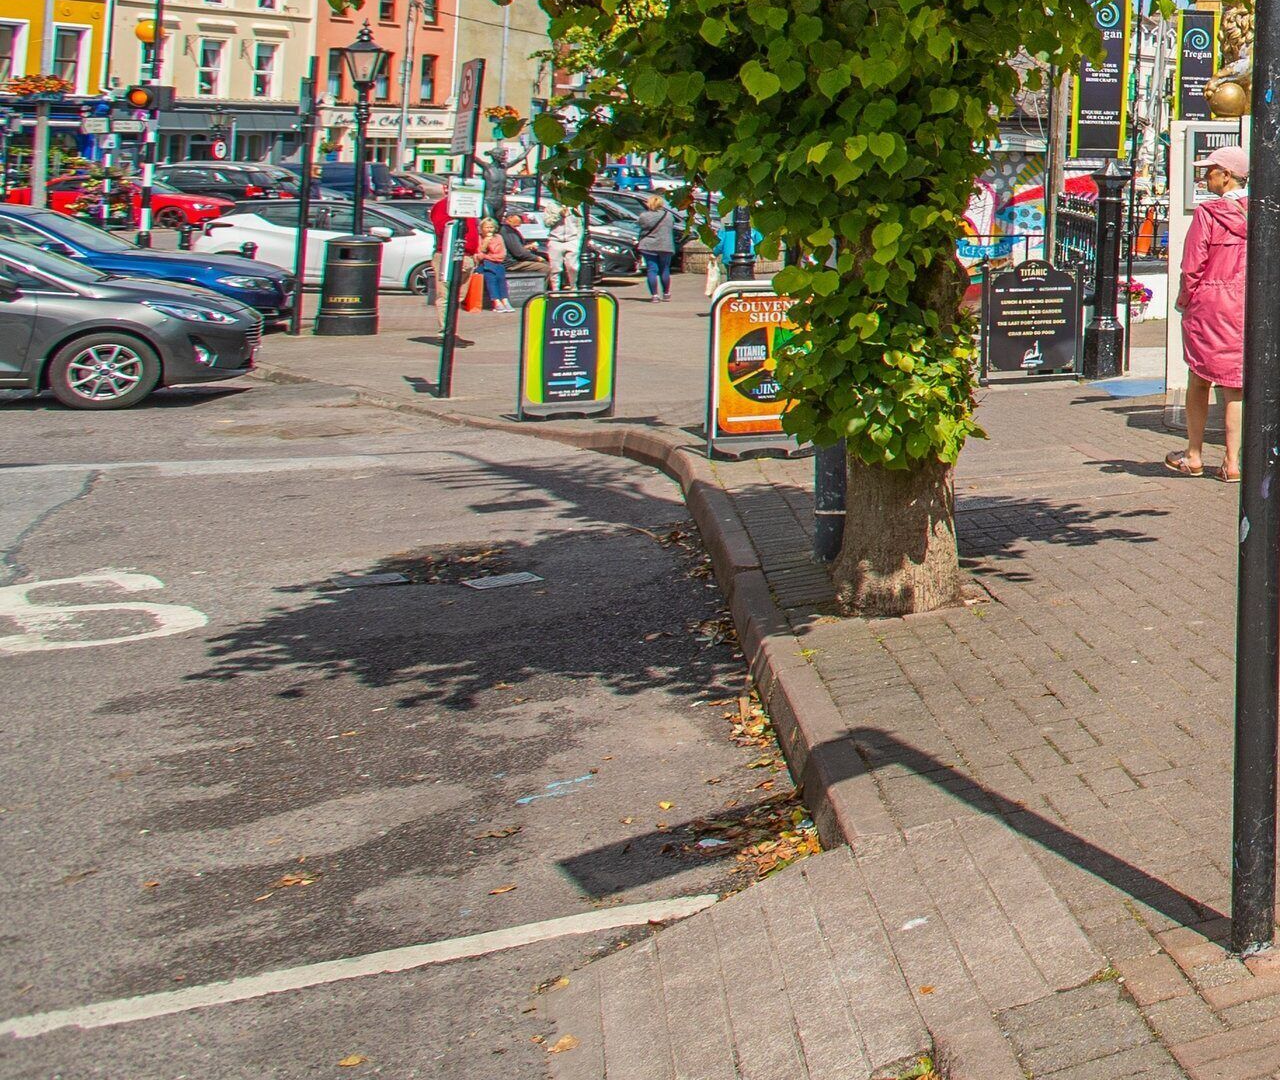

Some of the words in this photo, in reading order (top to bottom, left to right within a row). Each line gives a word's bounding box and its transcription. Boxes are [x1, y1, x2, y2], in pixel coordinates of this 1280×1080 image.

[1103, 30, 1123, 41] gan
[1183, 50, 1212, 59] Tregan
[1020, 268, 1048, 276] TITANIC
[729, 299, 800, 313] SOUVEN
[551, 328, 590, 338] Tregan
[735, 345, 767, 357] TITANIC
